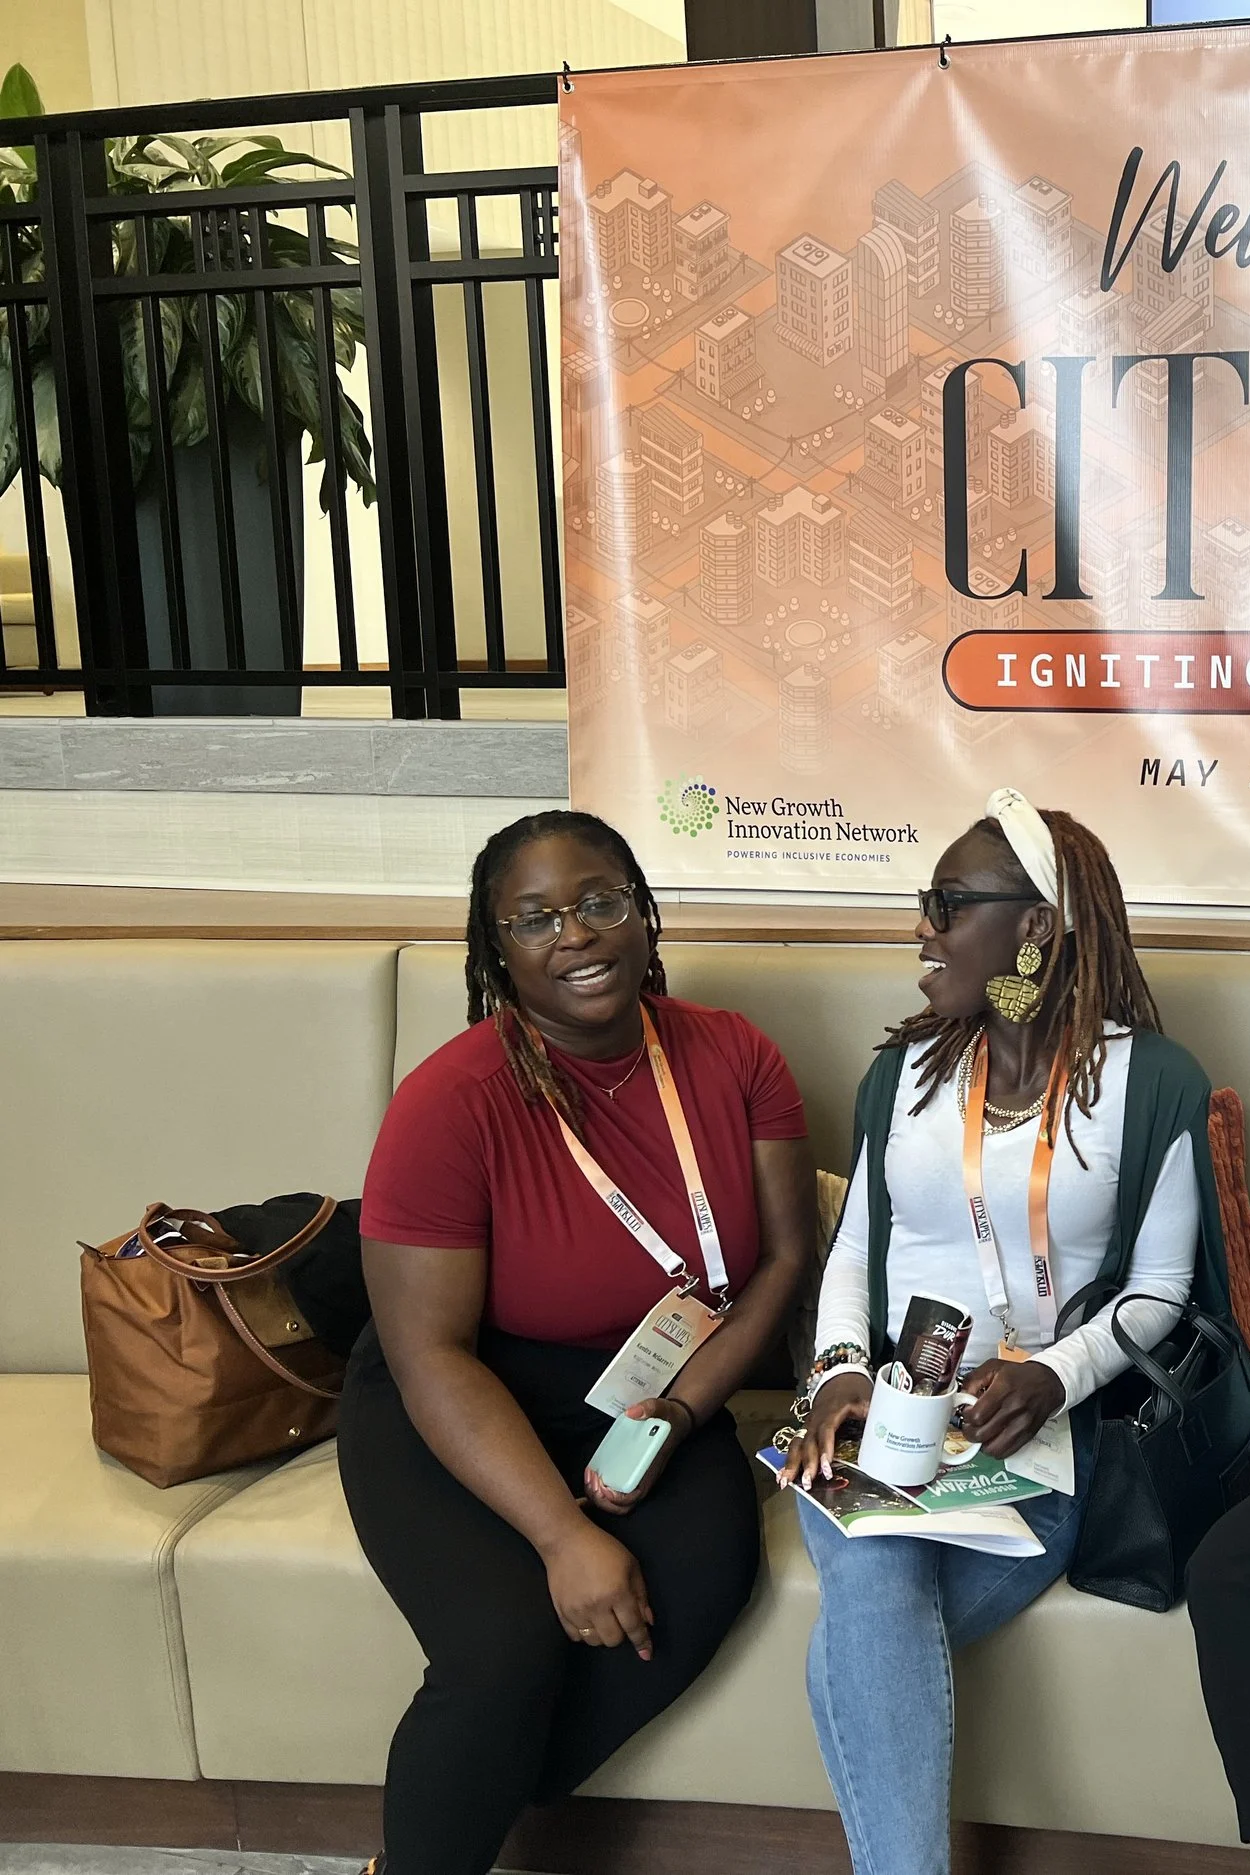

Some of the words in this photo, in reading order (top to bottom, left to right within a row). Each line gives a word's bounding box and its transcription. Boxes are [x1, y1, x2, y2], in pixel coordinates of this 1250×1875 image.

[1140, 758, 1219, 787] MAY
[725, 797, 767, 816] New
[771, 797, 844, 817] Growth
[727, 820, 832, 840] Innovation
[835, 822, 919, 843] Network
[727, 850, 778, 859] POWERING
[782, 852, 831, 861] INCLUSIVE
[835, 853, 891, 862] ECONOMIES
[973, 1196, 991, 1241] CITYSCAPES
[923, 1470, 1017, 1497] DURHAM
